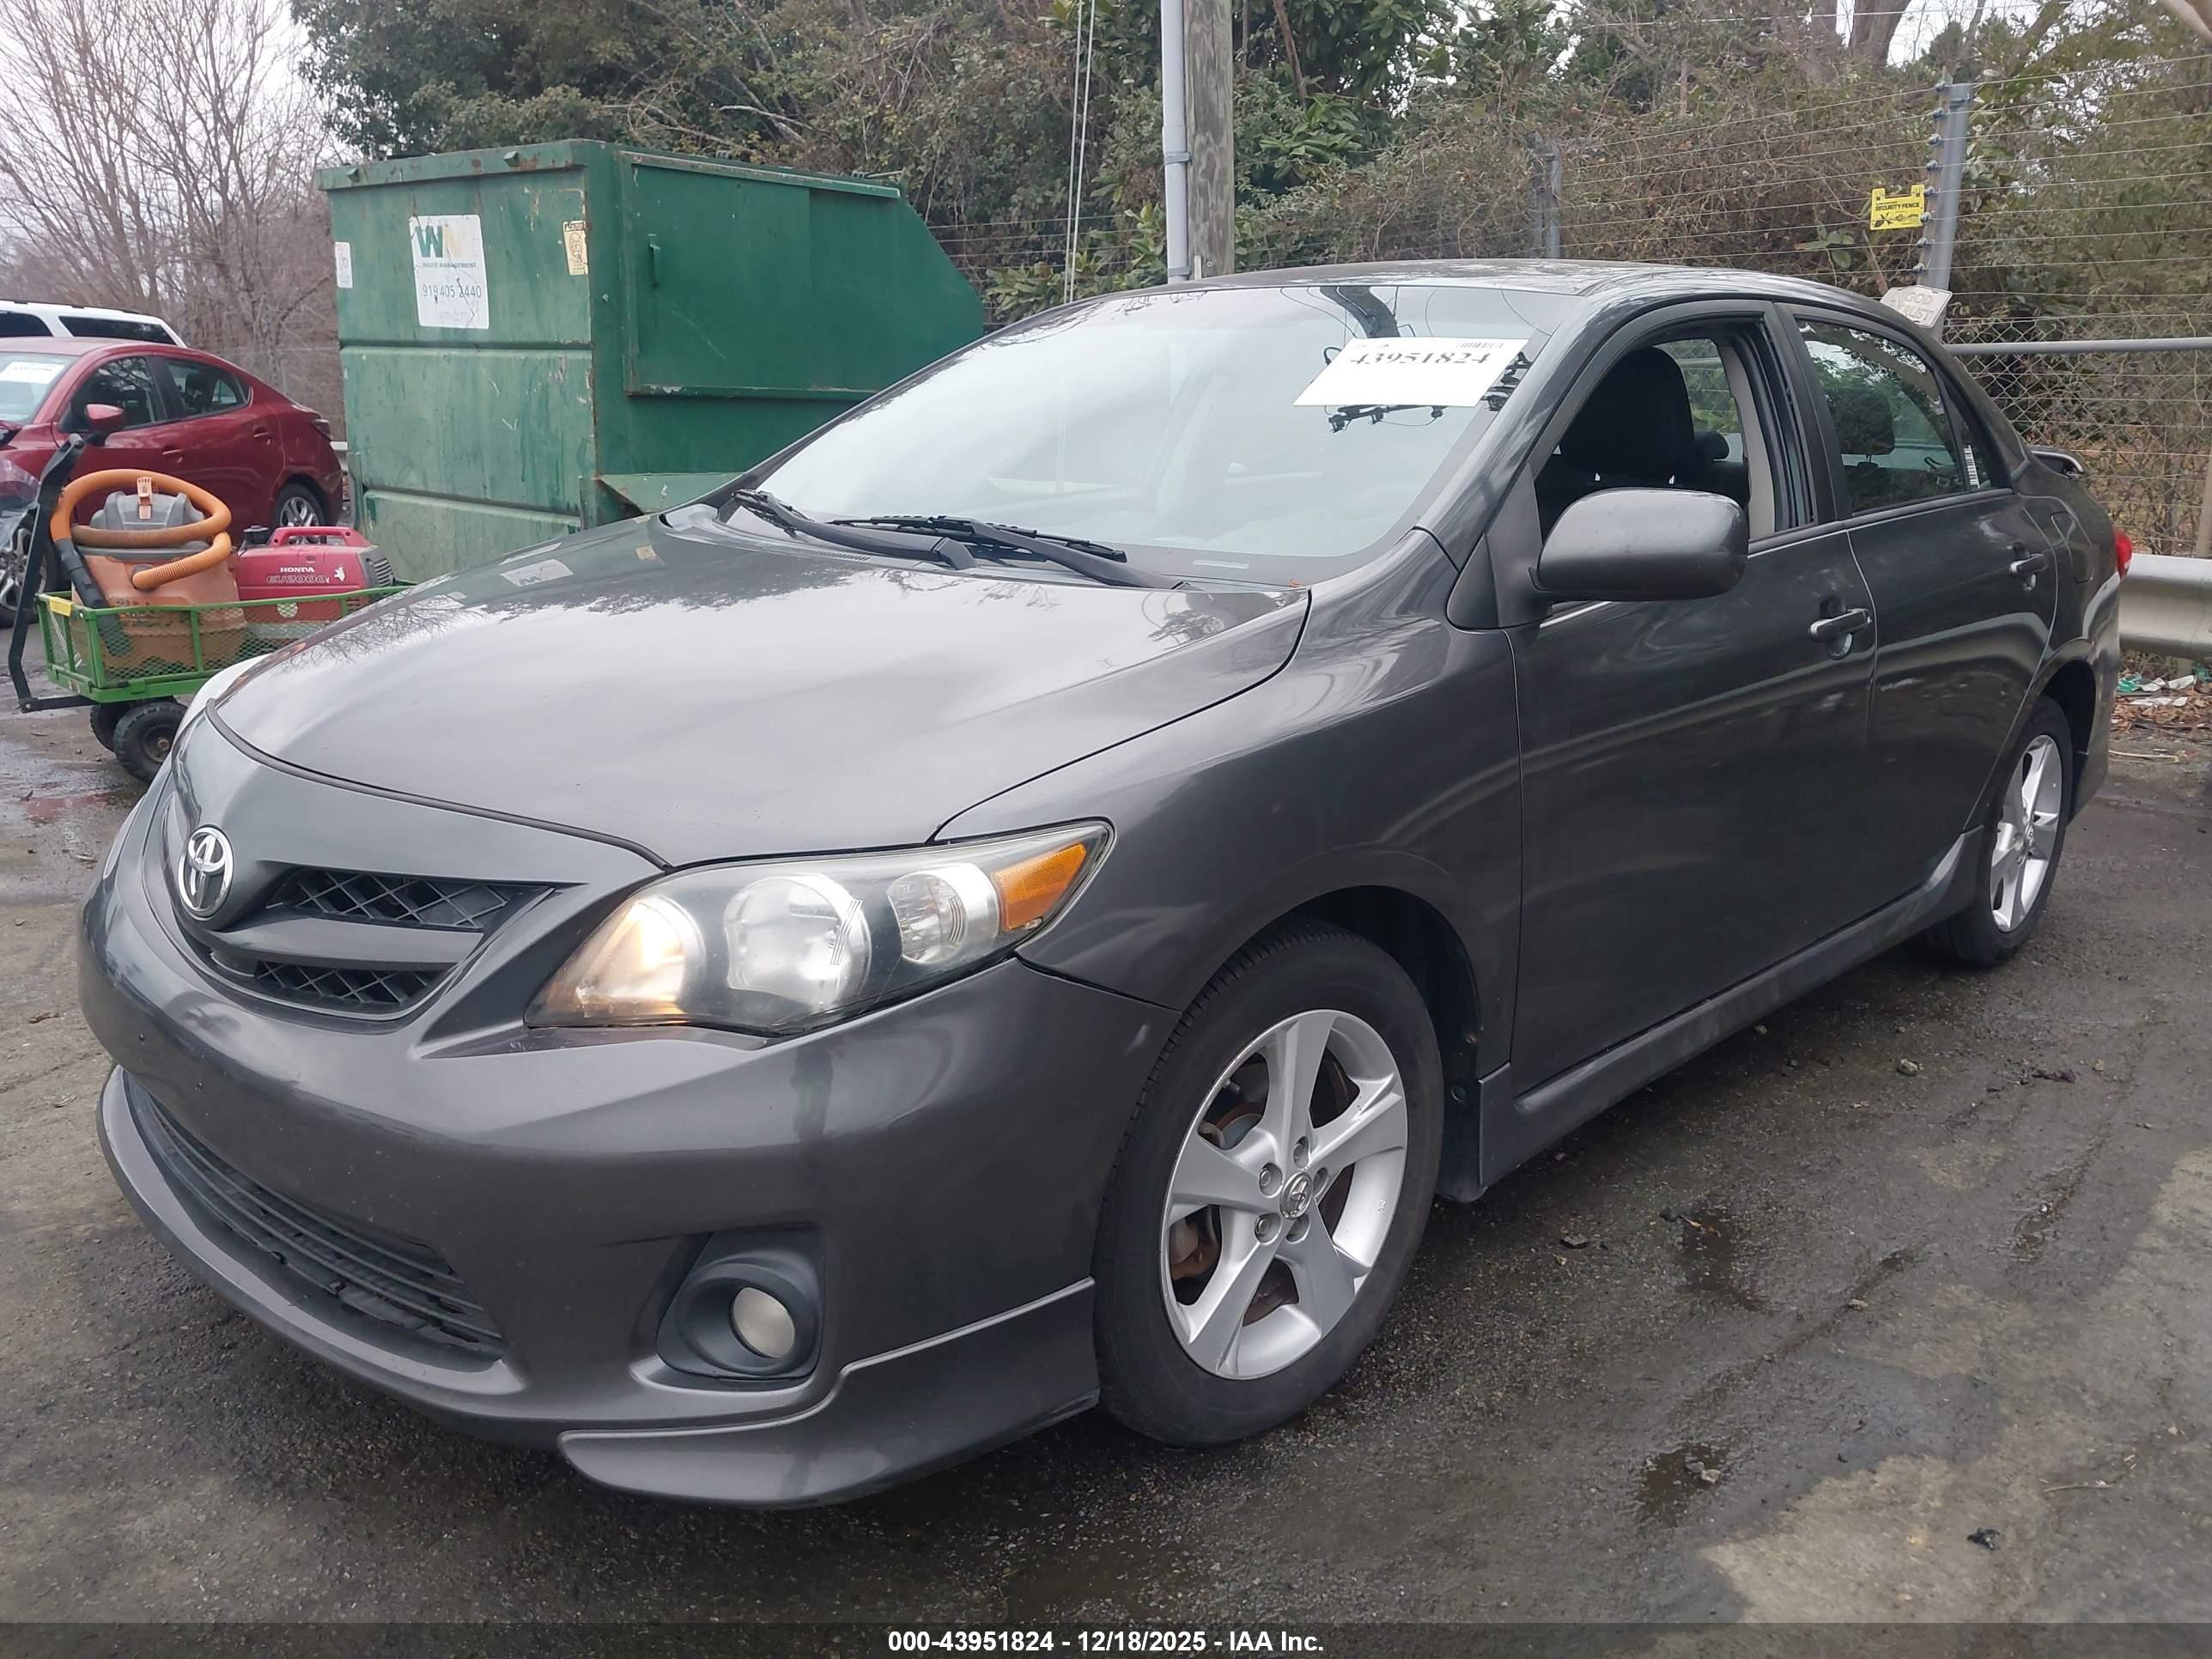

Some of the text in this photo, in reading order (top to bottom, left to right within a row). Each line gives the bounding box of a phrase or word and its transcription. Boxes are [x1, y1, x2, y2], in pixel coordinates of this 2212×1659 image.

[440, 284, 455, 298] 405
[459, 284, 482, 299] 2440
[1905, 292, 1935, 305] GOD
[1900, 305, 1934, 321] RUST
[1351, 352, 1491, 365] 43951824
